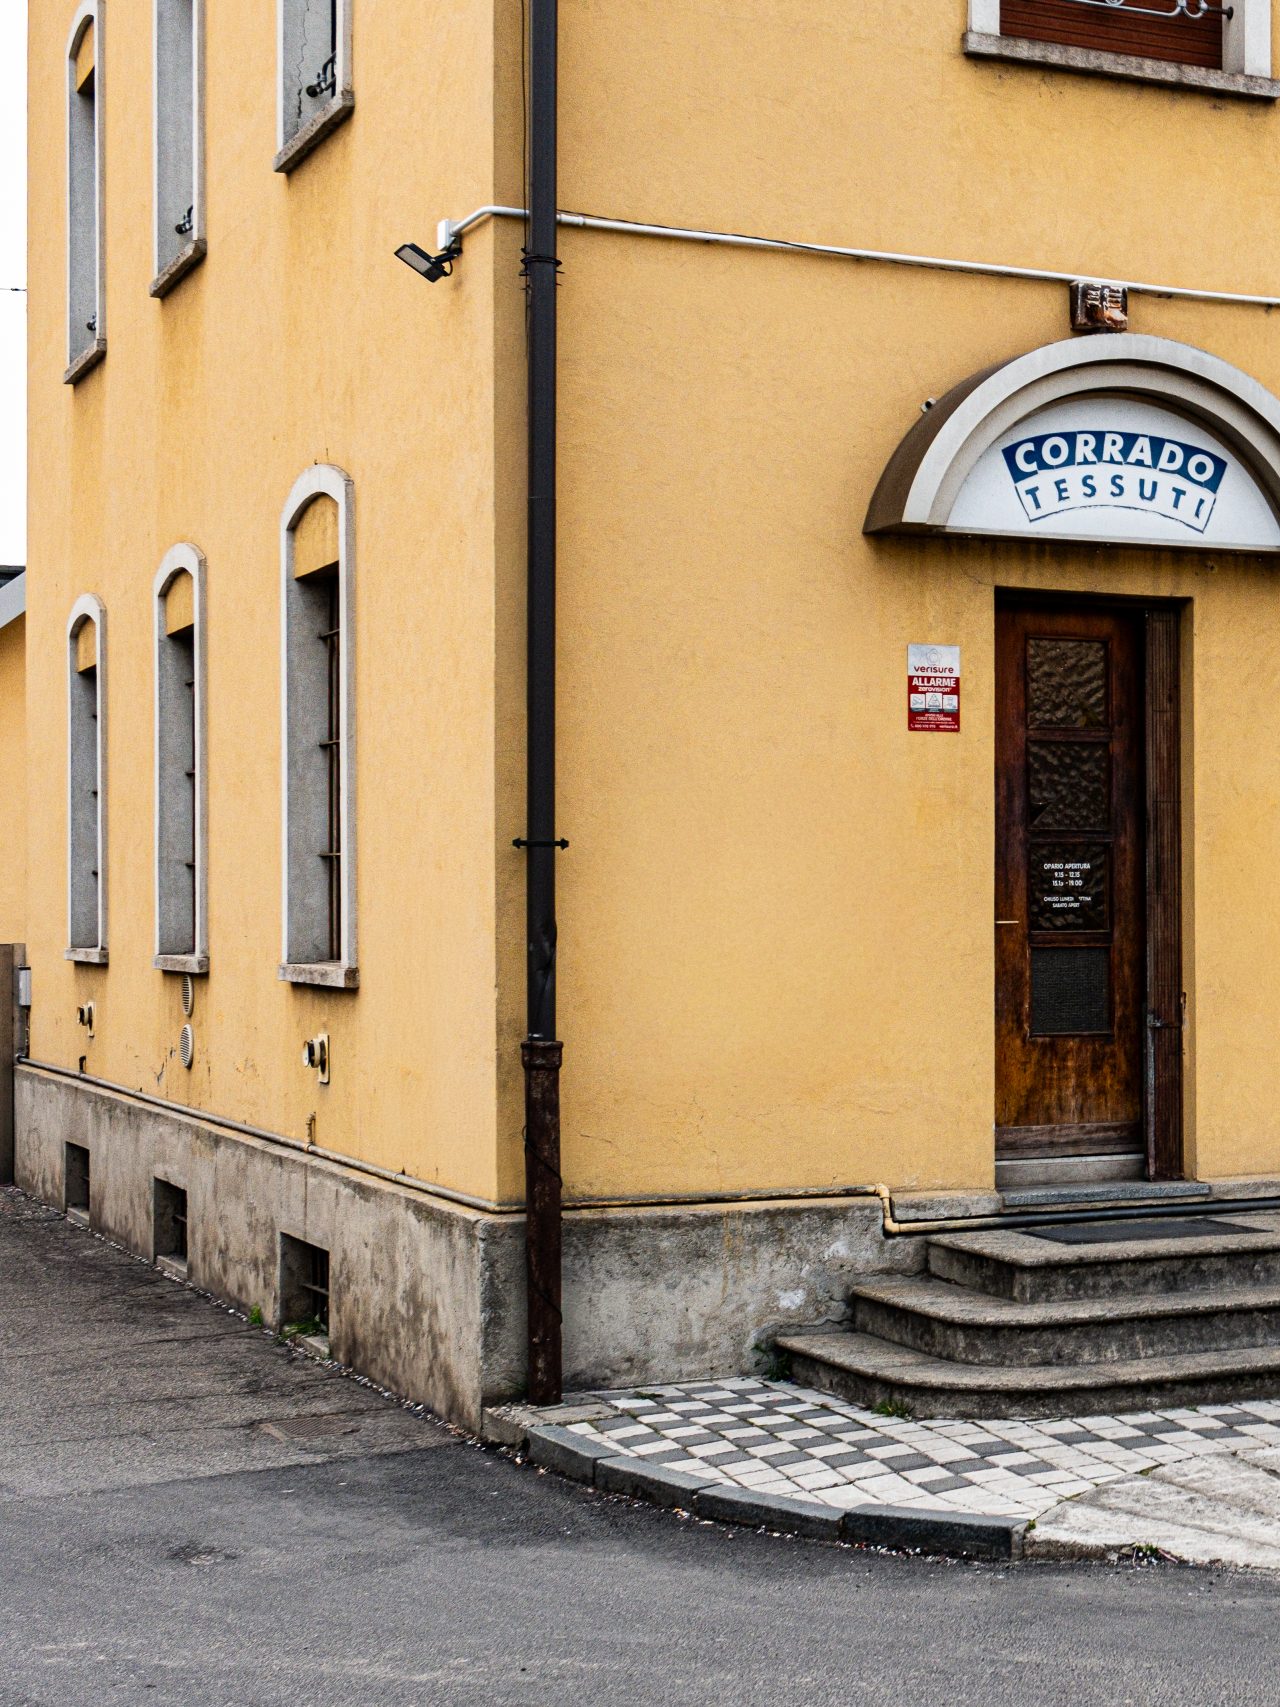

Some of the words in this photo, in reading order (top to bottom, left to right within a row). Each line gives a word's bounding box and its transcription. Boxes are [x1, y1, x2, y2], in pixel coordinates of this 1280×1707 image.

[1014, 433, 1215, 483] CORRADO
[1024, 474, 1206, 519] TESSUTI
[912, 677, 956, 687] ALLARME
[914, 666, 954, 674] verisure
